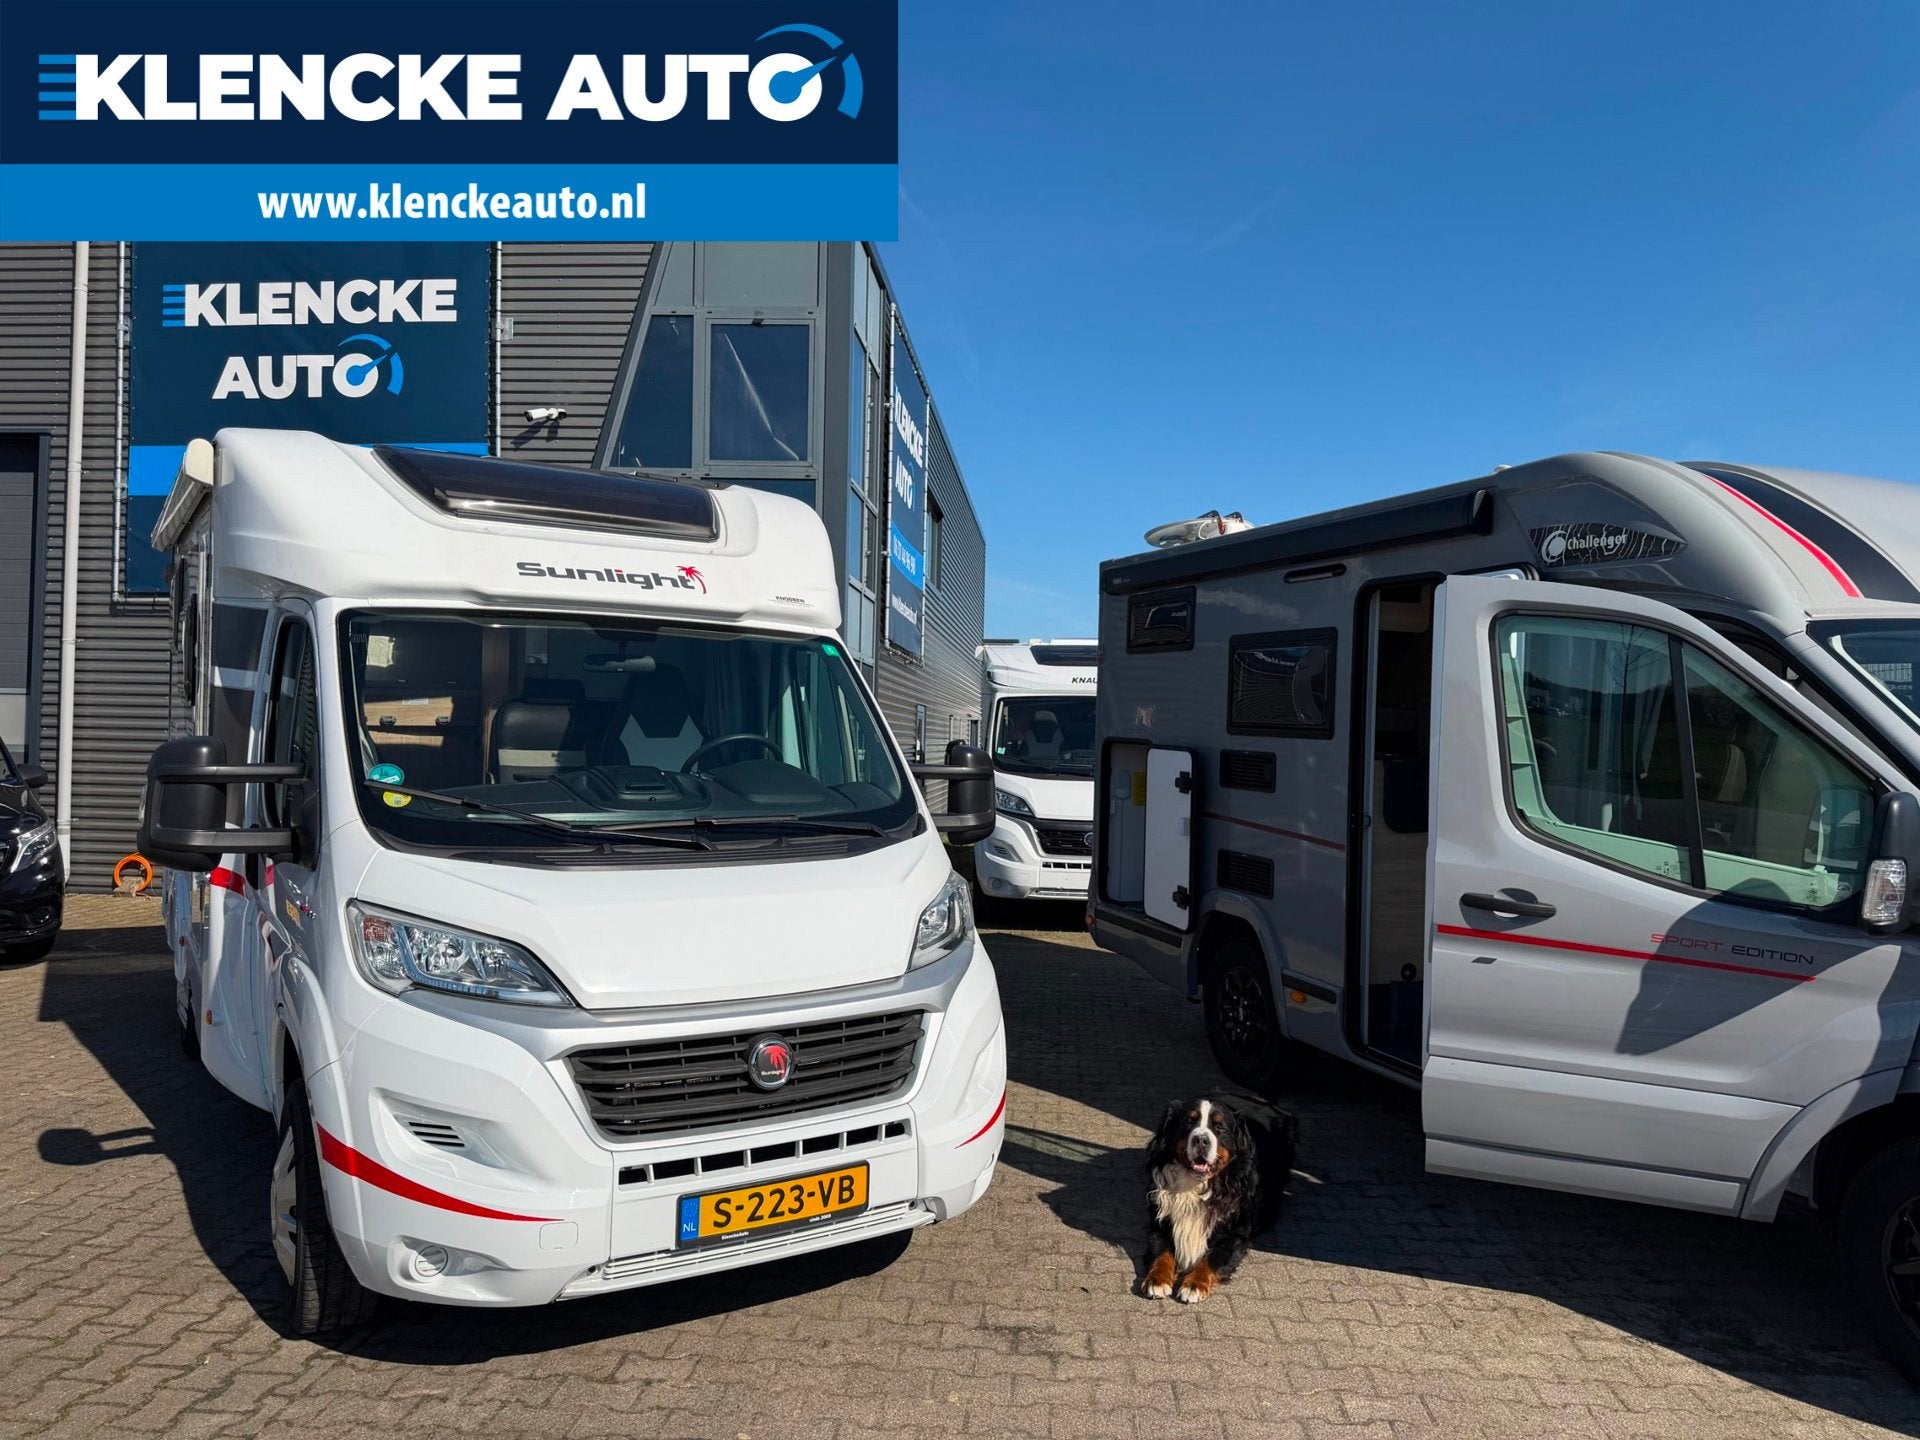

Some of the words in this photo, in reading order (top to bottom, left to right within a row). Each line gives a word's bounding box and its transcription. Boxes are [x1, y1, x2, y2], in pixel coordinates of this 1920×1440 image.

[184, 278, 458, 327] KLENCKE
[212, 352, 378, 400] AUTO
[894, 389, 924, 469] KLENCKE
[895, 454, 914, 509] AUTO
[1567, 533, 1628, 550] Challenger
[516, 562, 695, 590] Sunlight
[1650, 933, 1723, 951] SPORT
[1731, 945, 1814, 965] EDITION
[713, 1174, 855, 1228] S-223-VB
[682, 1222, 697, 1233] NL
